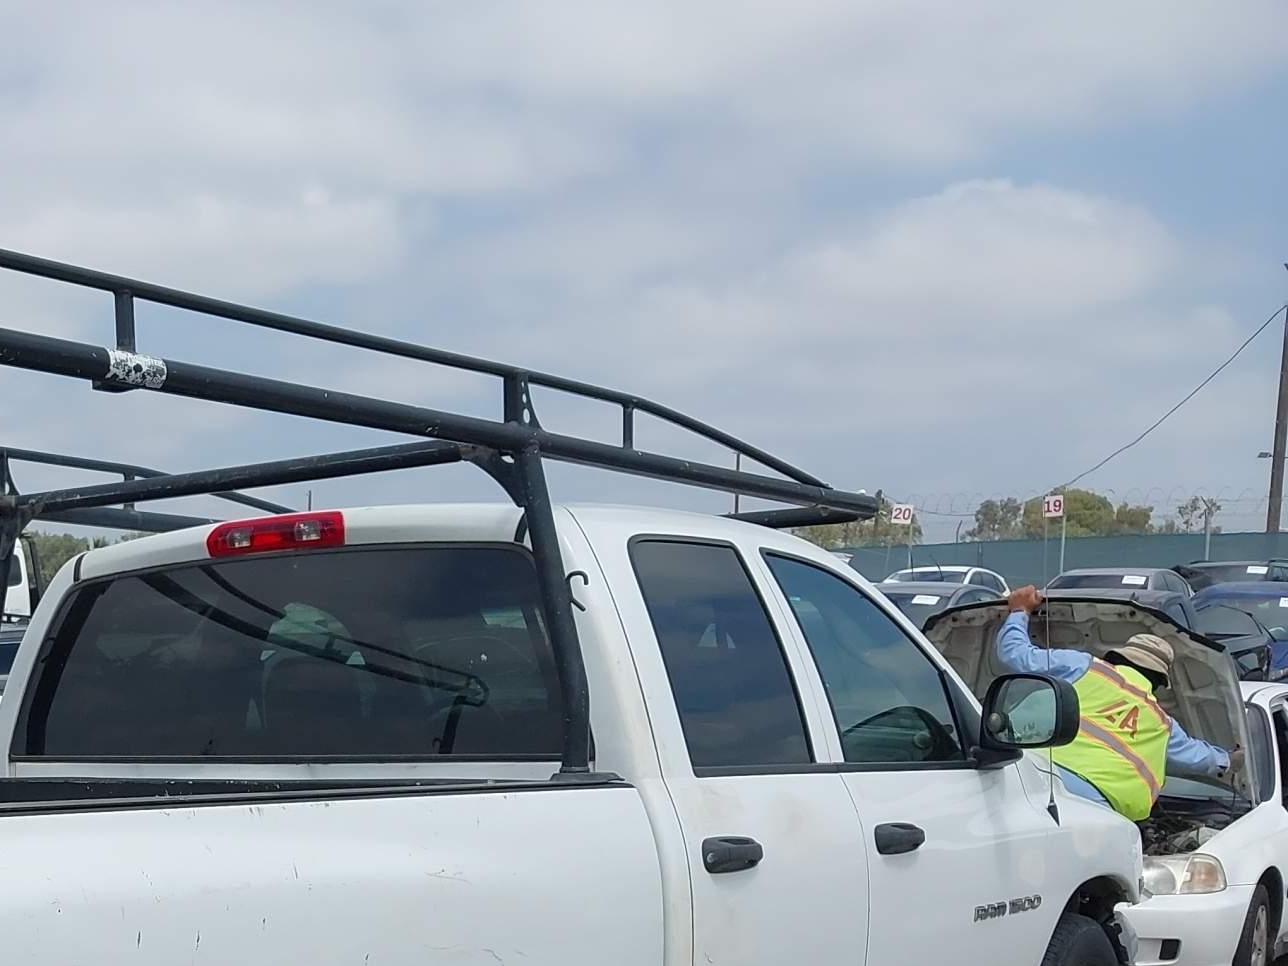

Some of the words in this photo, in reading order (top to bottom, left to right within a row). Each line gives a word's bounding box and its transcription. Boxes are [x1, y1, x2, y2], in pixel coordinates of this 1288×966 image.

[1044, 499, 1063, 513] 19
[893, 507, 912, 521] 20
[973, 901, 1007, 922] RAM
[1009, 894, 1042, 915] 1500
